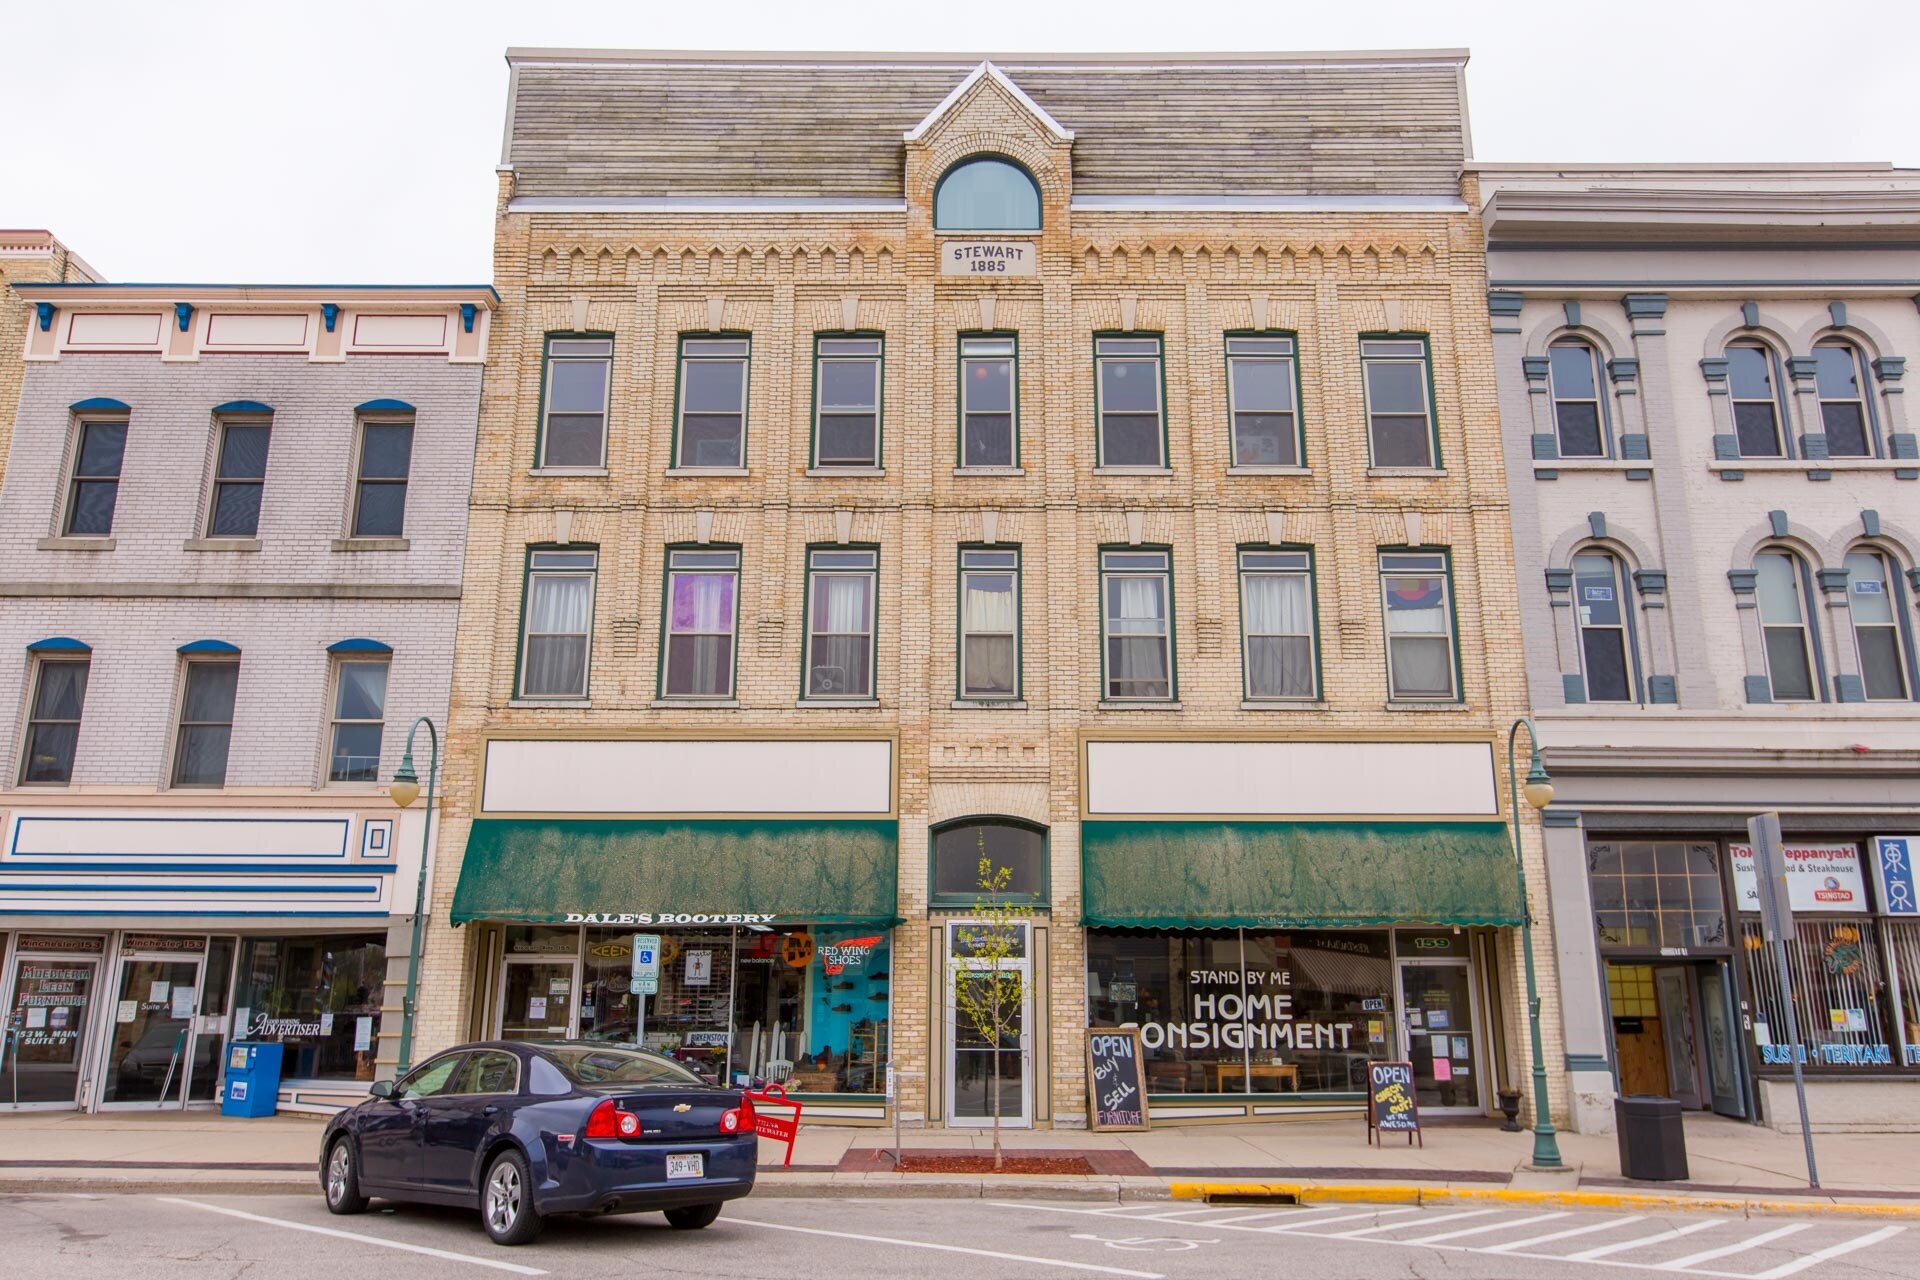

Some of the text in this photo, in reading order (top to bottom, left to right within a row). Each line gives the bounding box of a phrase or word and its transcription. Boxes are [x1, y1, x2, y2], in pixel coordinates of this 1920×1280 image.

[954, 246, 1023, 260] STEWART
[971, 260, 1006, 272] 1885
[1784, 847, 1855, 860] eppanyaki
[1736, 864, 1756, 872] Sush
[1808, 864, 1853, 873] Steakhouse
[1817, 892, 1850, 900] TSINGTAO
[565, 913, 776, 924] DALE'S BOOTERY
[20, 940, 101, 949] Winchester 153
[126, 938, 204, 949] Winchester 153
[1415, 938, 1450, 948] 159
[591, 946, 631, 957] KEEN
[818, 947, 870, 956] RED WING
[829, 956, 860, 964] SHOES
[1191, 970, 1290, 984] STAND BY ME
[39, 980, 74, 992] LEON
[19, 993, 87, 1006] FURNITURE
[1365, 1000, 1382, 1010] OPEN
[1194, 994, 1292, 1020] HOME
[247, 1013, 320, 1035] ADVERTISER
[1119, 1022, 1353, 1049] ONSIGNMENT
[1092, 1036, 1132, 1057] OPEN
[1762, 1044, 1892, 1064] SUSI TERIYAKI
[1095, 1056, 1119, 1080] BUY
[1372, 1066, 1410, 1084] OPEN
[1104, 1082, 1135, 1111] SELL
[1375, 1083, 1404, 1103] CHECK
[1389, 1092, 1404, 1103] US
[1390, 1096, 1413, 1114] OUT!
[1098, 1110, 1142, 1125] FURNITURE
[757, 1120, 778, 1128] THINK
[1380, 1120, 1417, 1128] AWESOME
[756, 1126, 788, 1138] ITEWATER
